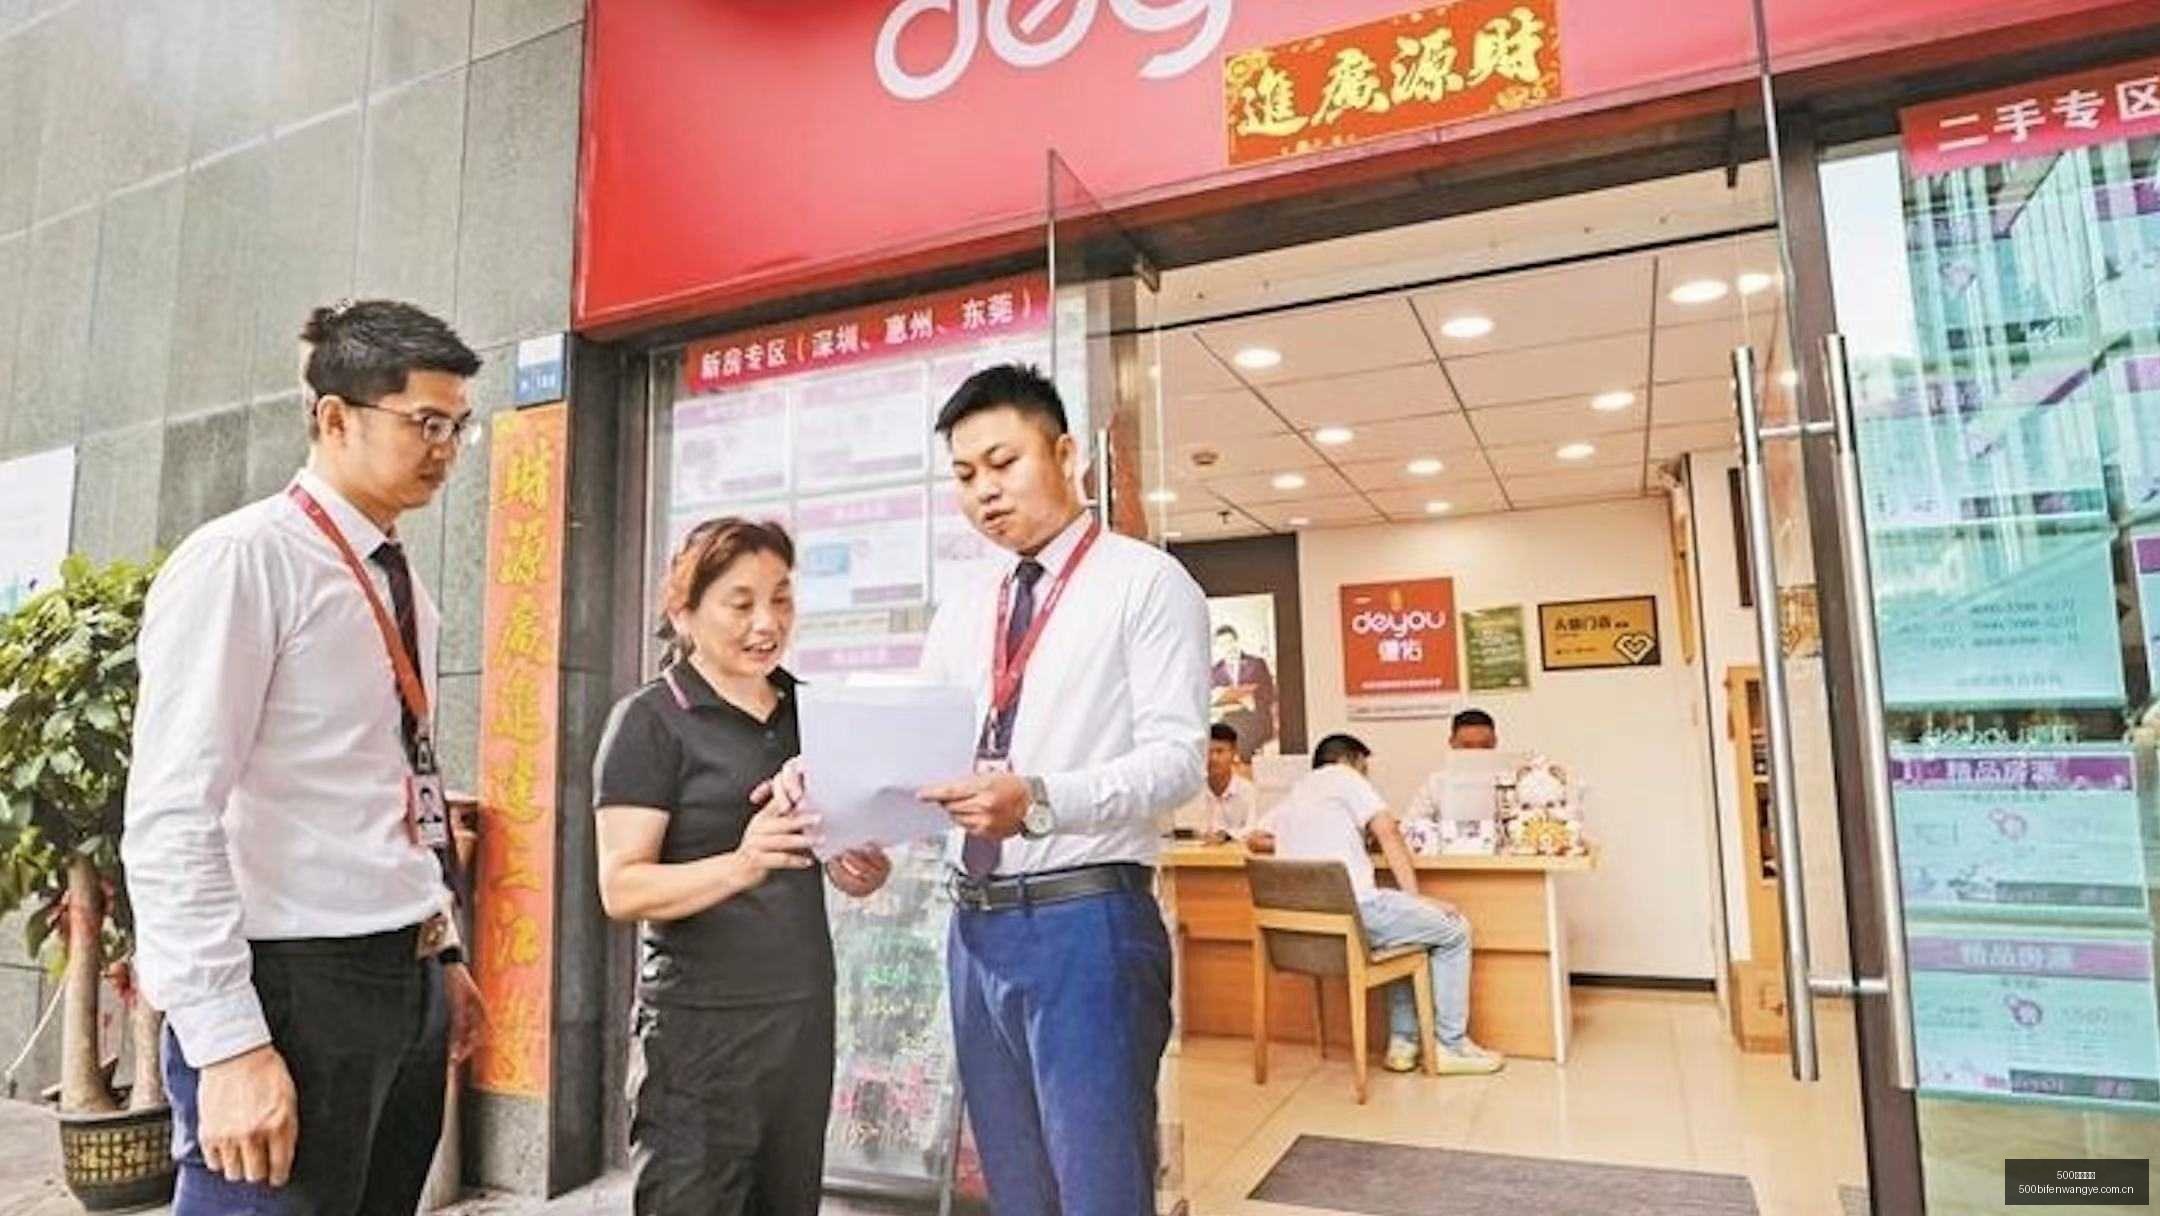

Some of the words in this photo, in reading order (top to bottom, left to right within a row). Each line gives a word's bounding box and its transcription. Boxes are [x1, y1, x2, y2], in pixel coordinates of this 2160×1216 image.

[1938, 80, 2160, 151] 二手专区
[1351, 609, 1447, 638] deyou
